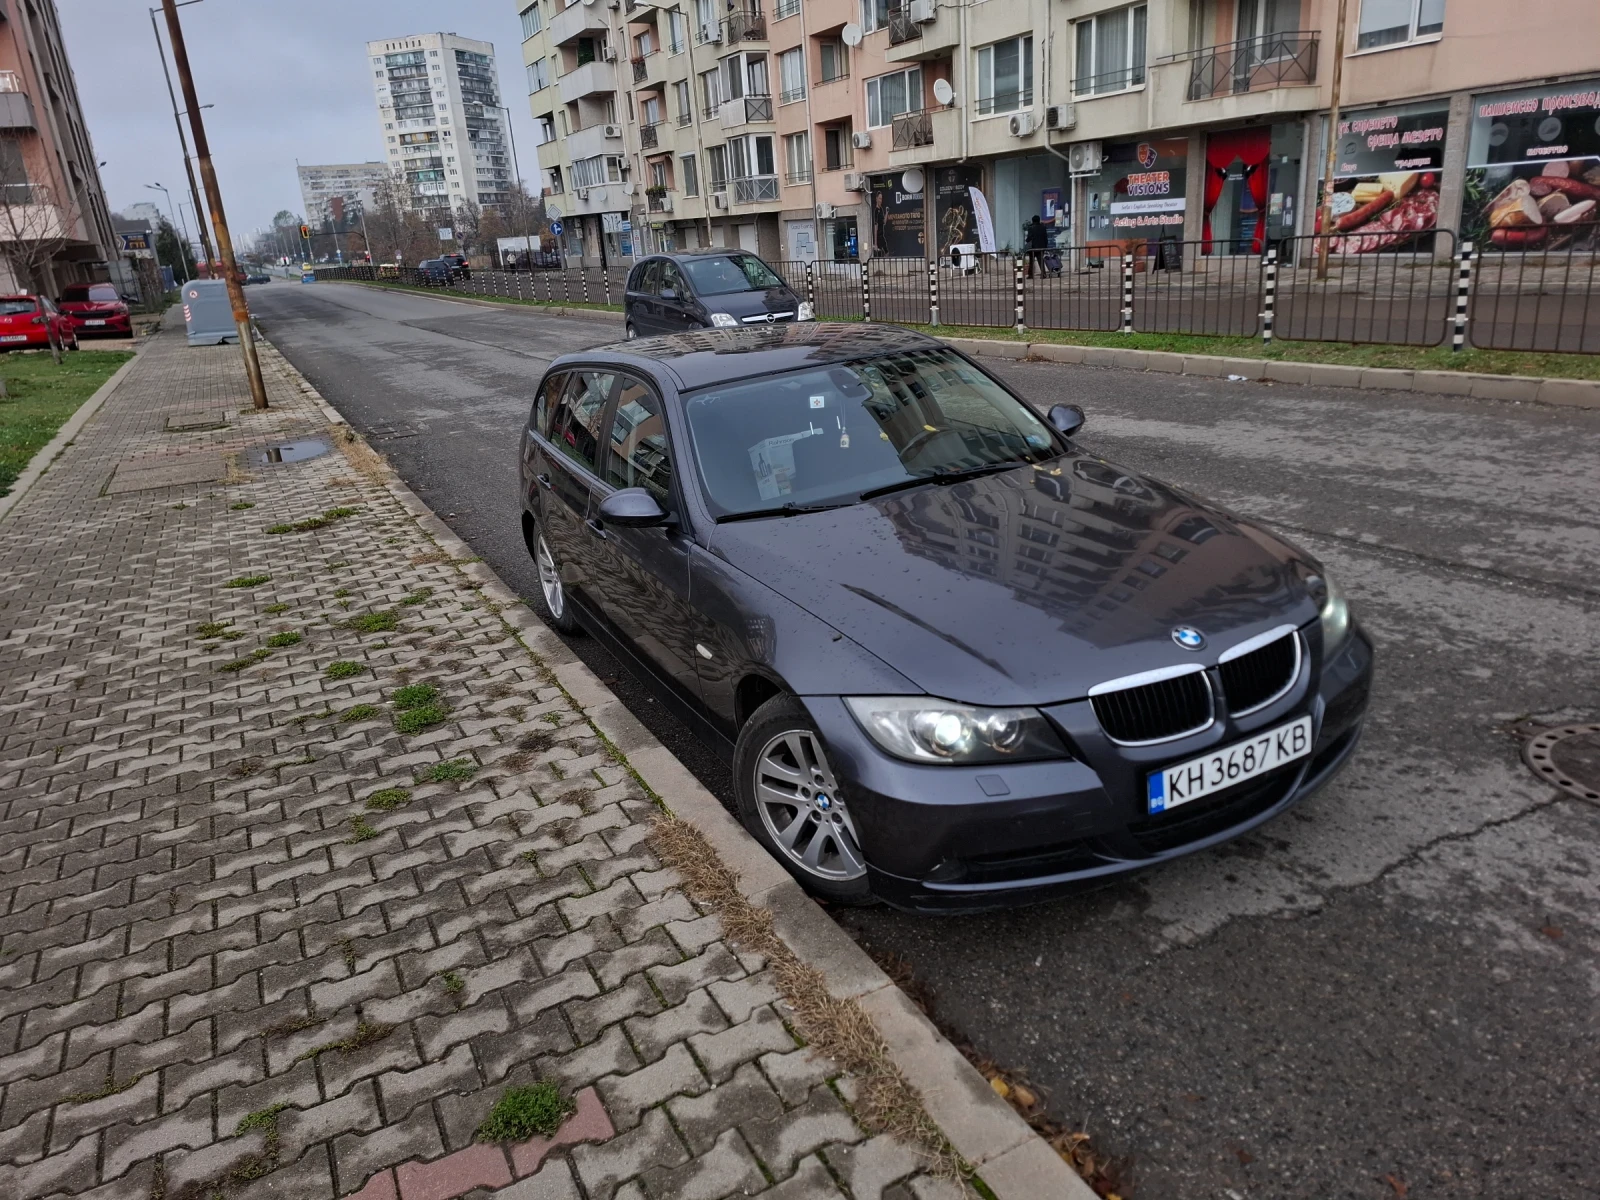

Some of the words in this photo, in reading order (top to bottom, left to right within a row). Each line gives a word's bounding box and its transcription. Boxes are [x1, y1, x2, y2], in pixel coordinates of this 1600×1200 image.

[1338, 122, 1349, 139] ук
[1128, 171, 1169, 184] THEATER
[1128, 183, 1169, 196] VISIONS
[1114, 217, 1136, 228] Acting
[1159, 213, 1184, 225] Studio
[1168, 761, 1204, 803] KH
[1211, 737, 1270, 786] 3687
[1277, 723, 1307, 760] KB
[1150, 796, 1163, 808] BG
